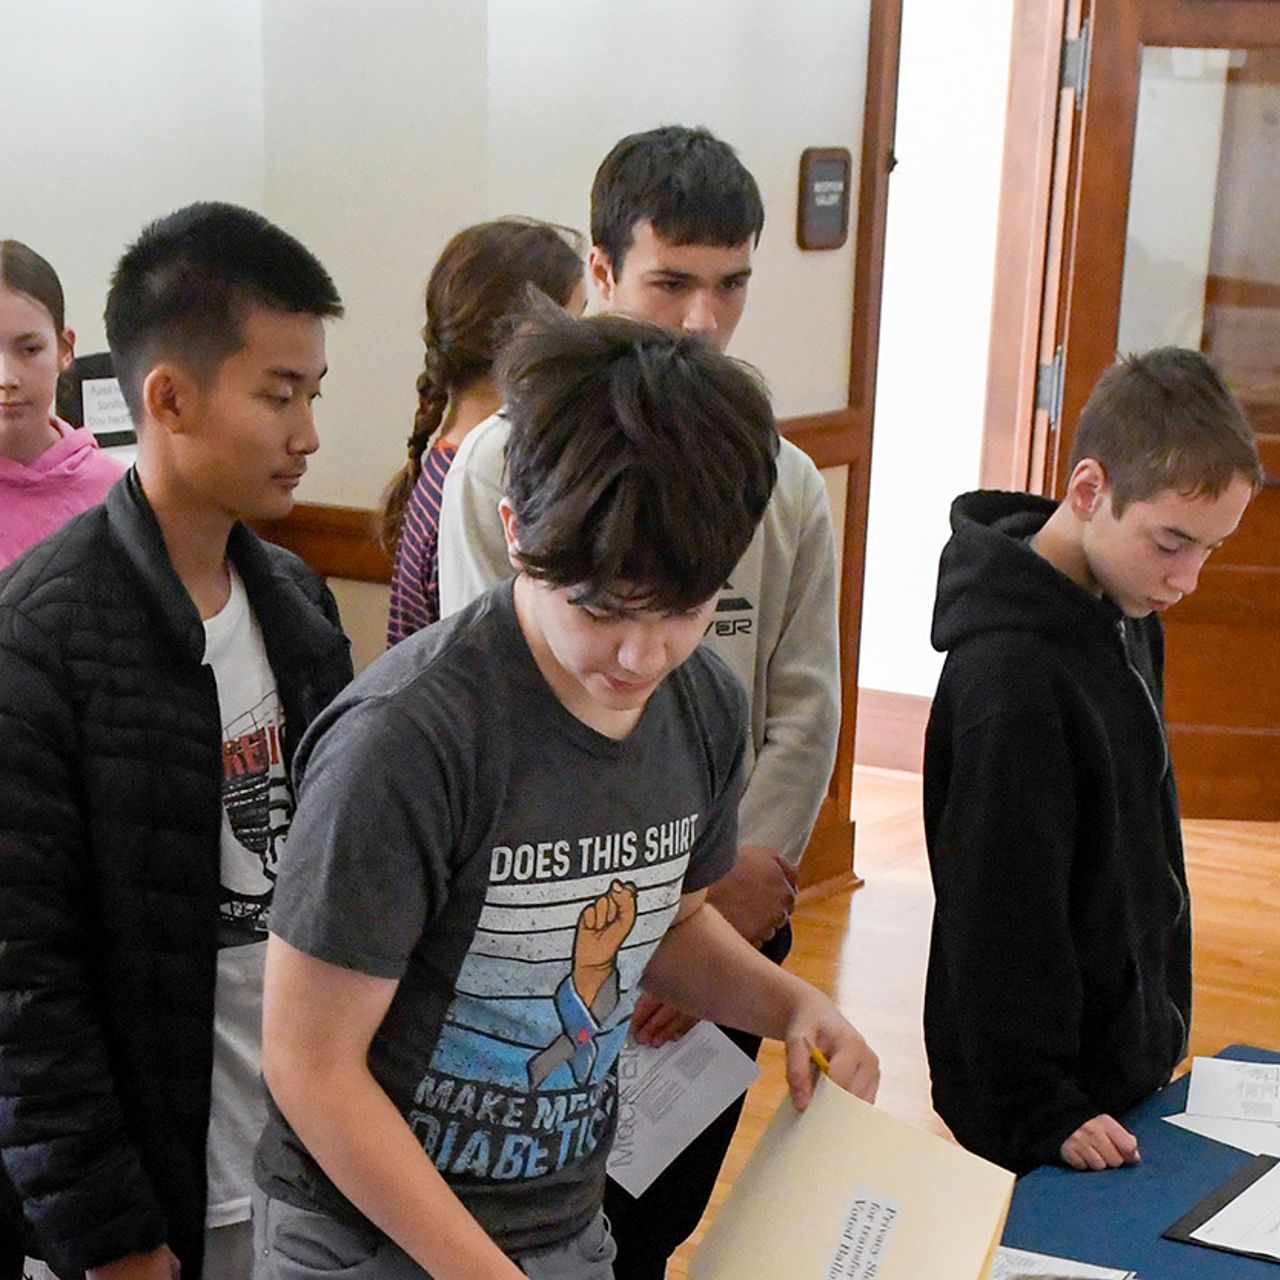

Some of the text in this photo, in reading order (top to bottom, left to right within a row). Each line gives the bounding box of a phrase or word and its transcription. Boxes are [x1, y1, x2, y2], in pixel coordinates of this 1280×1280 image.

[489, 813, 699, 882] DOES THIS SHIRT
[414, 1075, 526, 1128] MAKE
[409, 1107, 608, 1181] DIABETIC
[843, 1200, 866, 1240] Voted
[867, 1202, 880, 1221] for
[871, 1207, 896, 1255] Privacy
[846, 1225, 871, 1280] transfer
